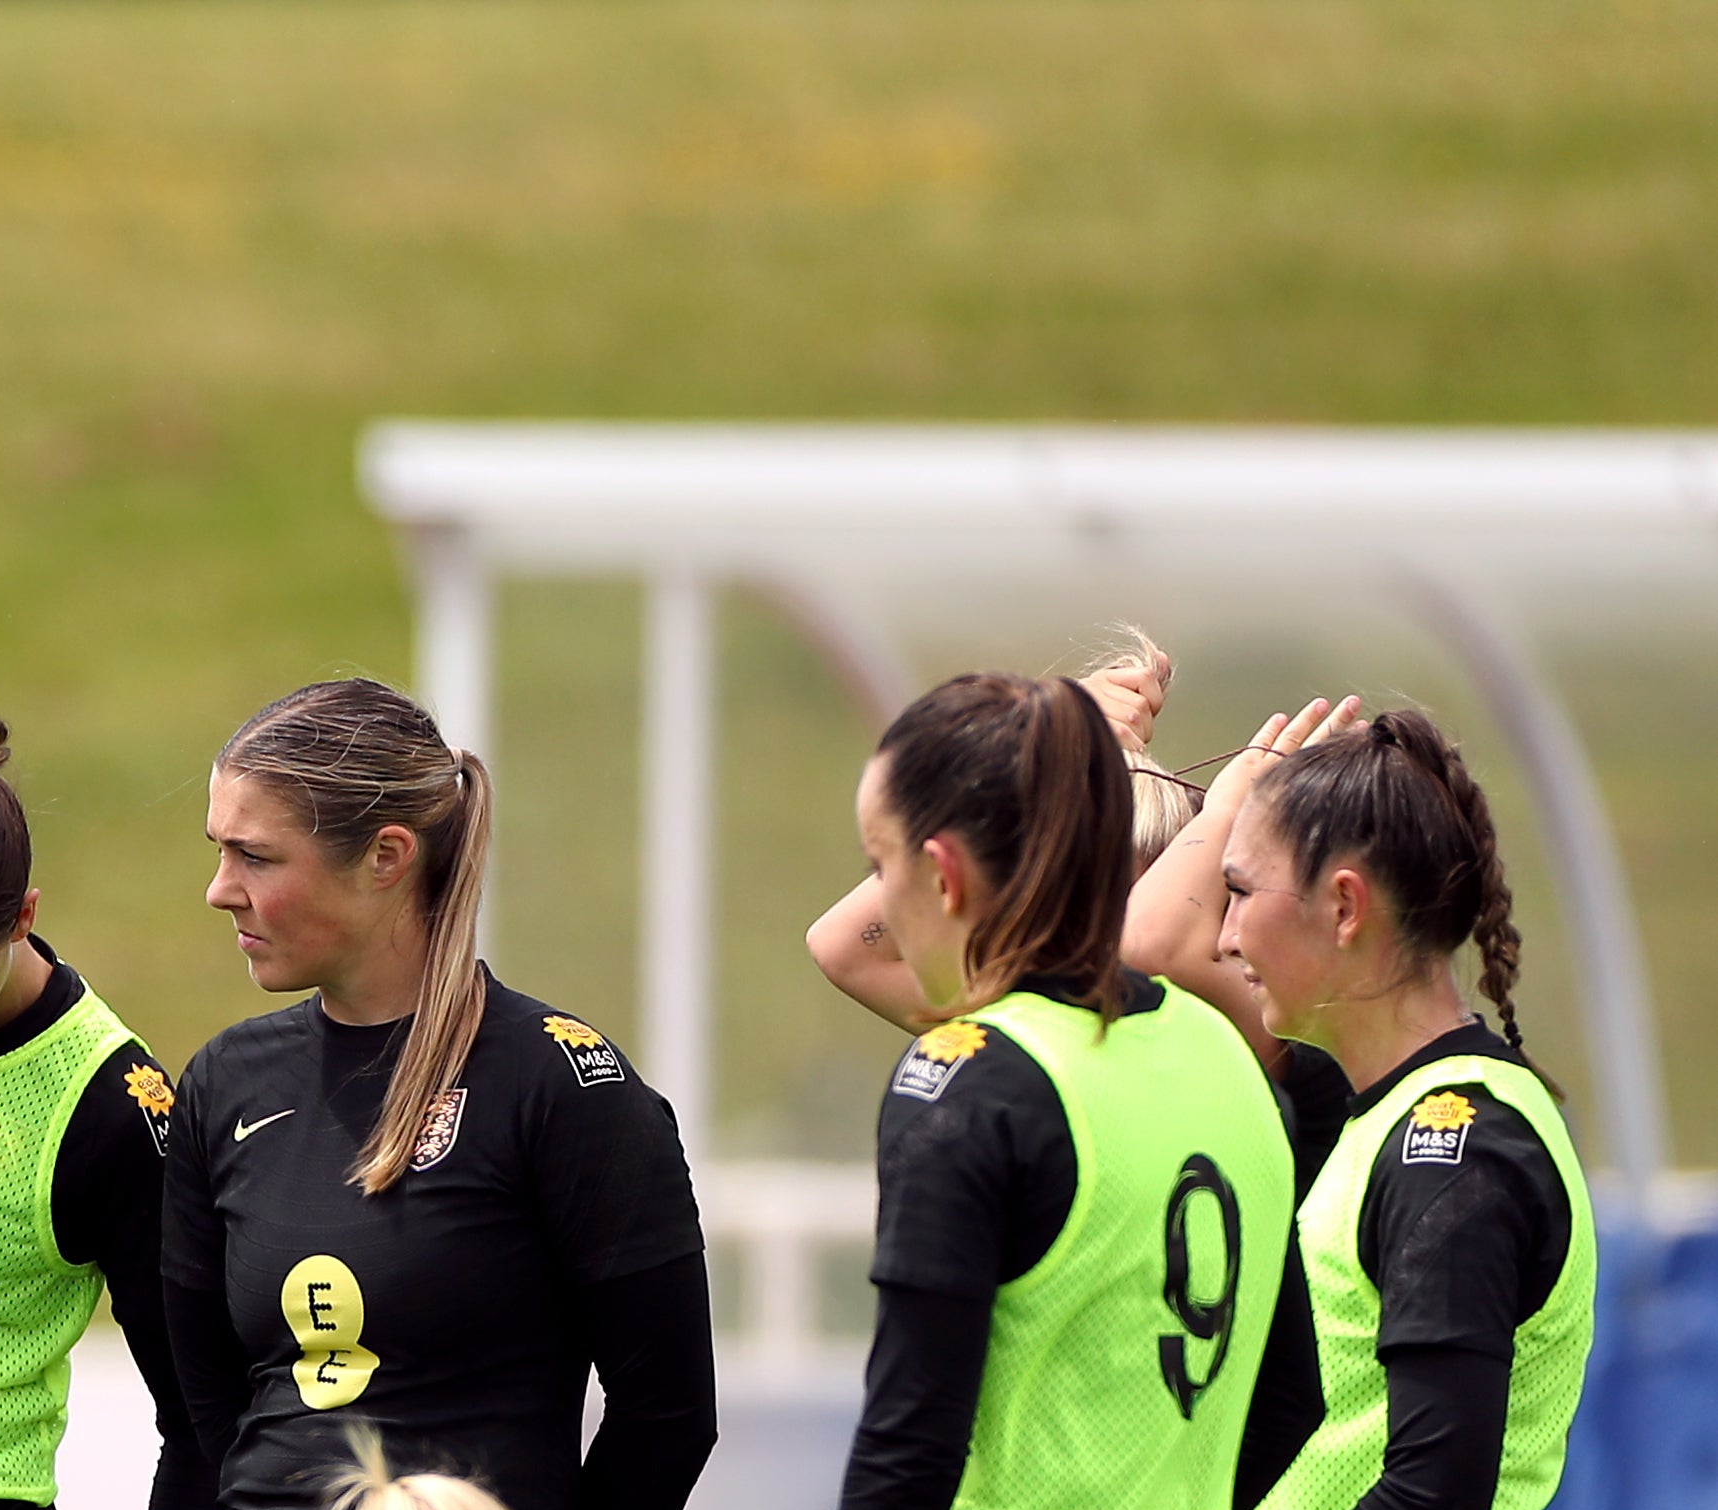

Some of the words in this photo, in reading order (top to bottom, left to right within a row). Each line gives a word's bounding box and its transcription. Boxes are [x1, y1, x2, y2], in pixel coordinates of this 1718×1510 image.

[576, 1050, 616, 1070] M&S
[1410, 1131, 1459, 1150] M&S
[1158, 1153, 1241, 1421] 9
